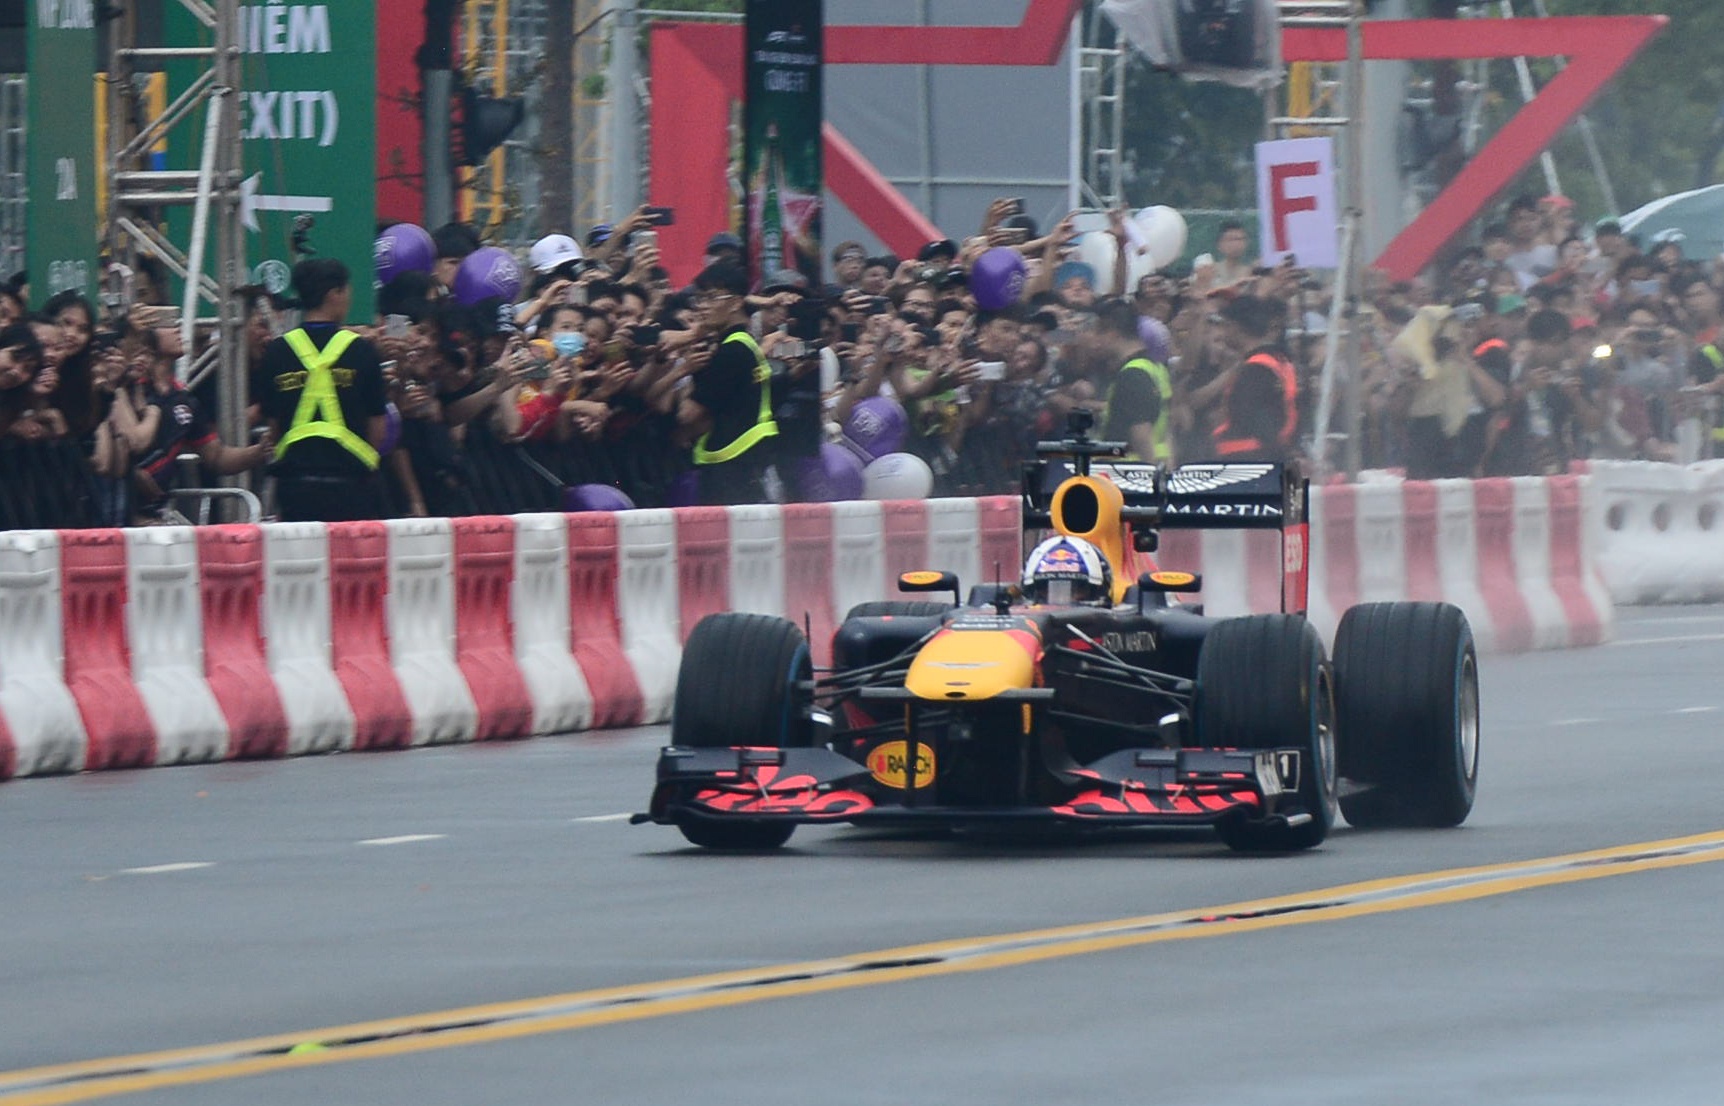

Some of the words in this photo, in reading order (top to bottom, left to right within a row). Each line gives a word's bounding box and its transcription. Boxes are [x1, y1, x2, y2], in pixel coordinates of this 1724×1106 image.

[1269, 160, 1320, 252] F
[1126, 470, 1153, 480] ASTO
[1172, 470, 1212, 480] MARTIN
[1166, 503, 1283, 516] MARTIN
[1125, 630, 1157, 653] MARTIN
[887, 754, 932, 775] RACH
